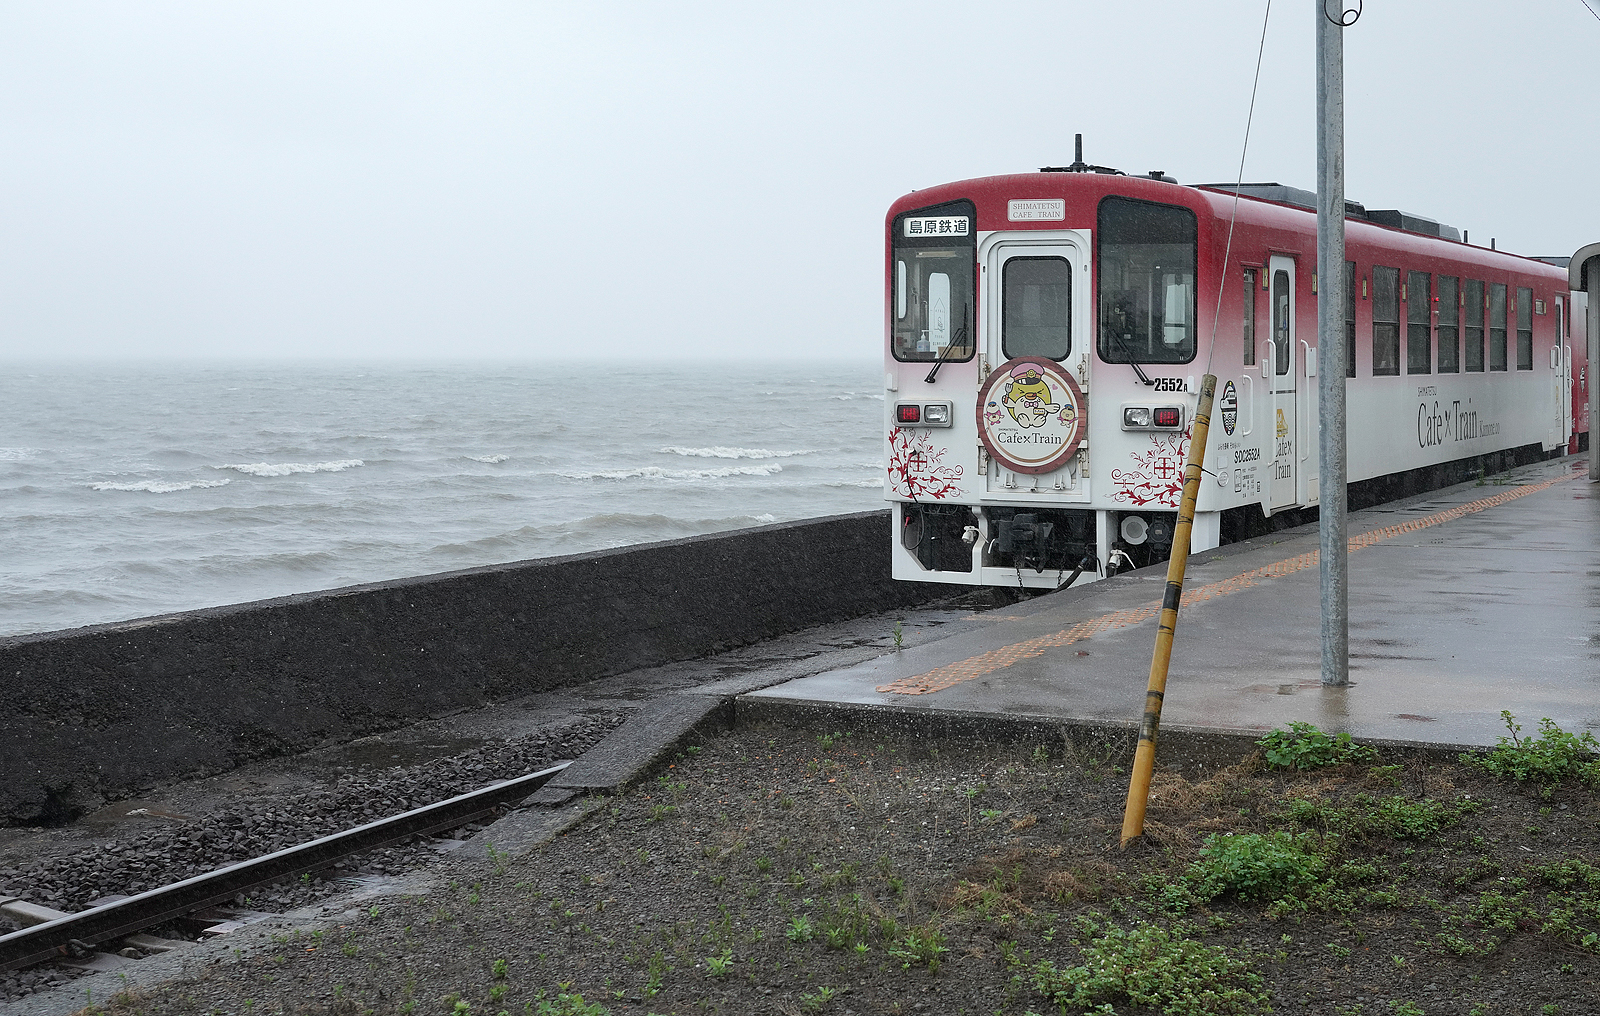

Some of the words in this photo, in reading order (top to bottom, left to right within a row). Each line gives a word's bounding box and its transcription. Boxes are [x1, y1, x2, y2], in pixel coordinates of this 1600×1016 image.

[1012, 202, 1061, 210] SHIMATETSU
[909, 219, 968, 235] 島原鉄道
[1417, 400, 1443, 448] Cafe
[1452, 397, 1478, 442] Train
[1274, 459, 1292, 480] Train
